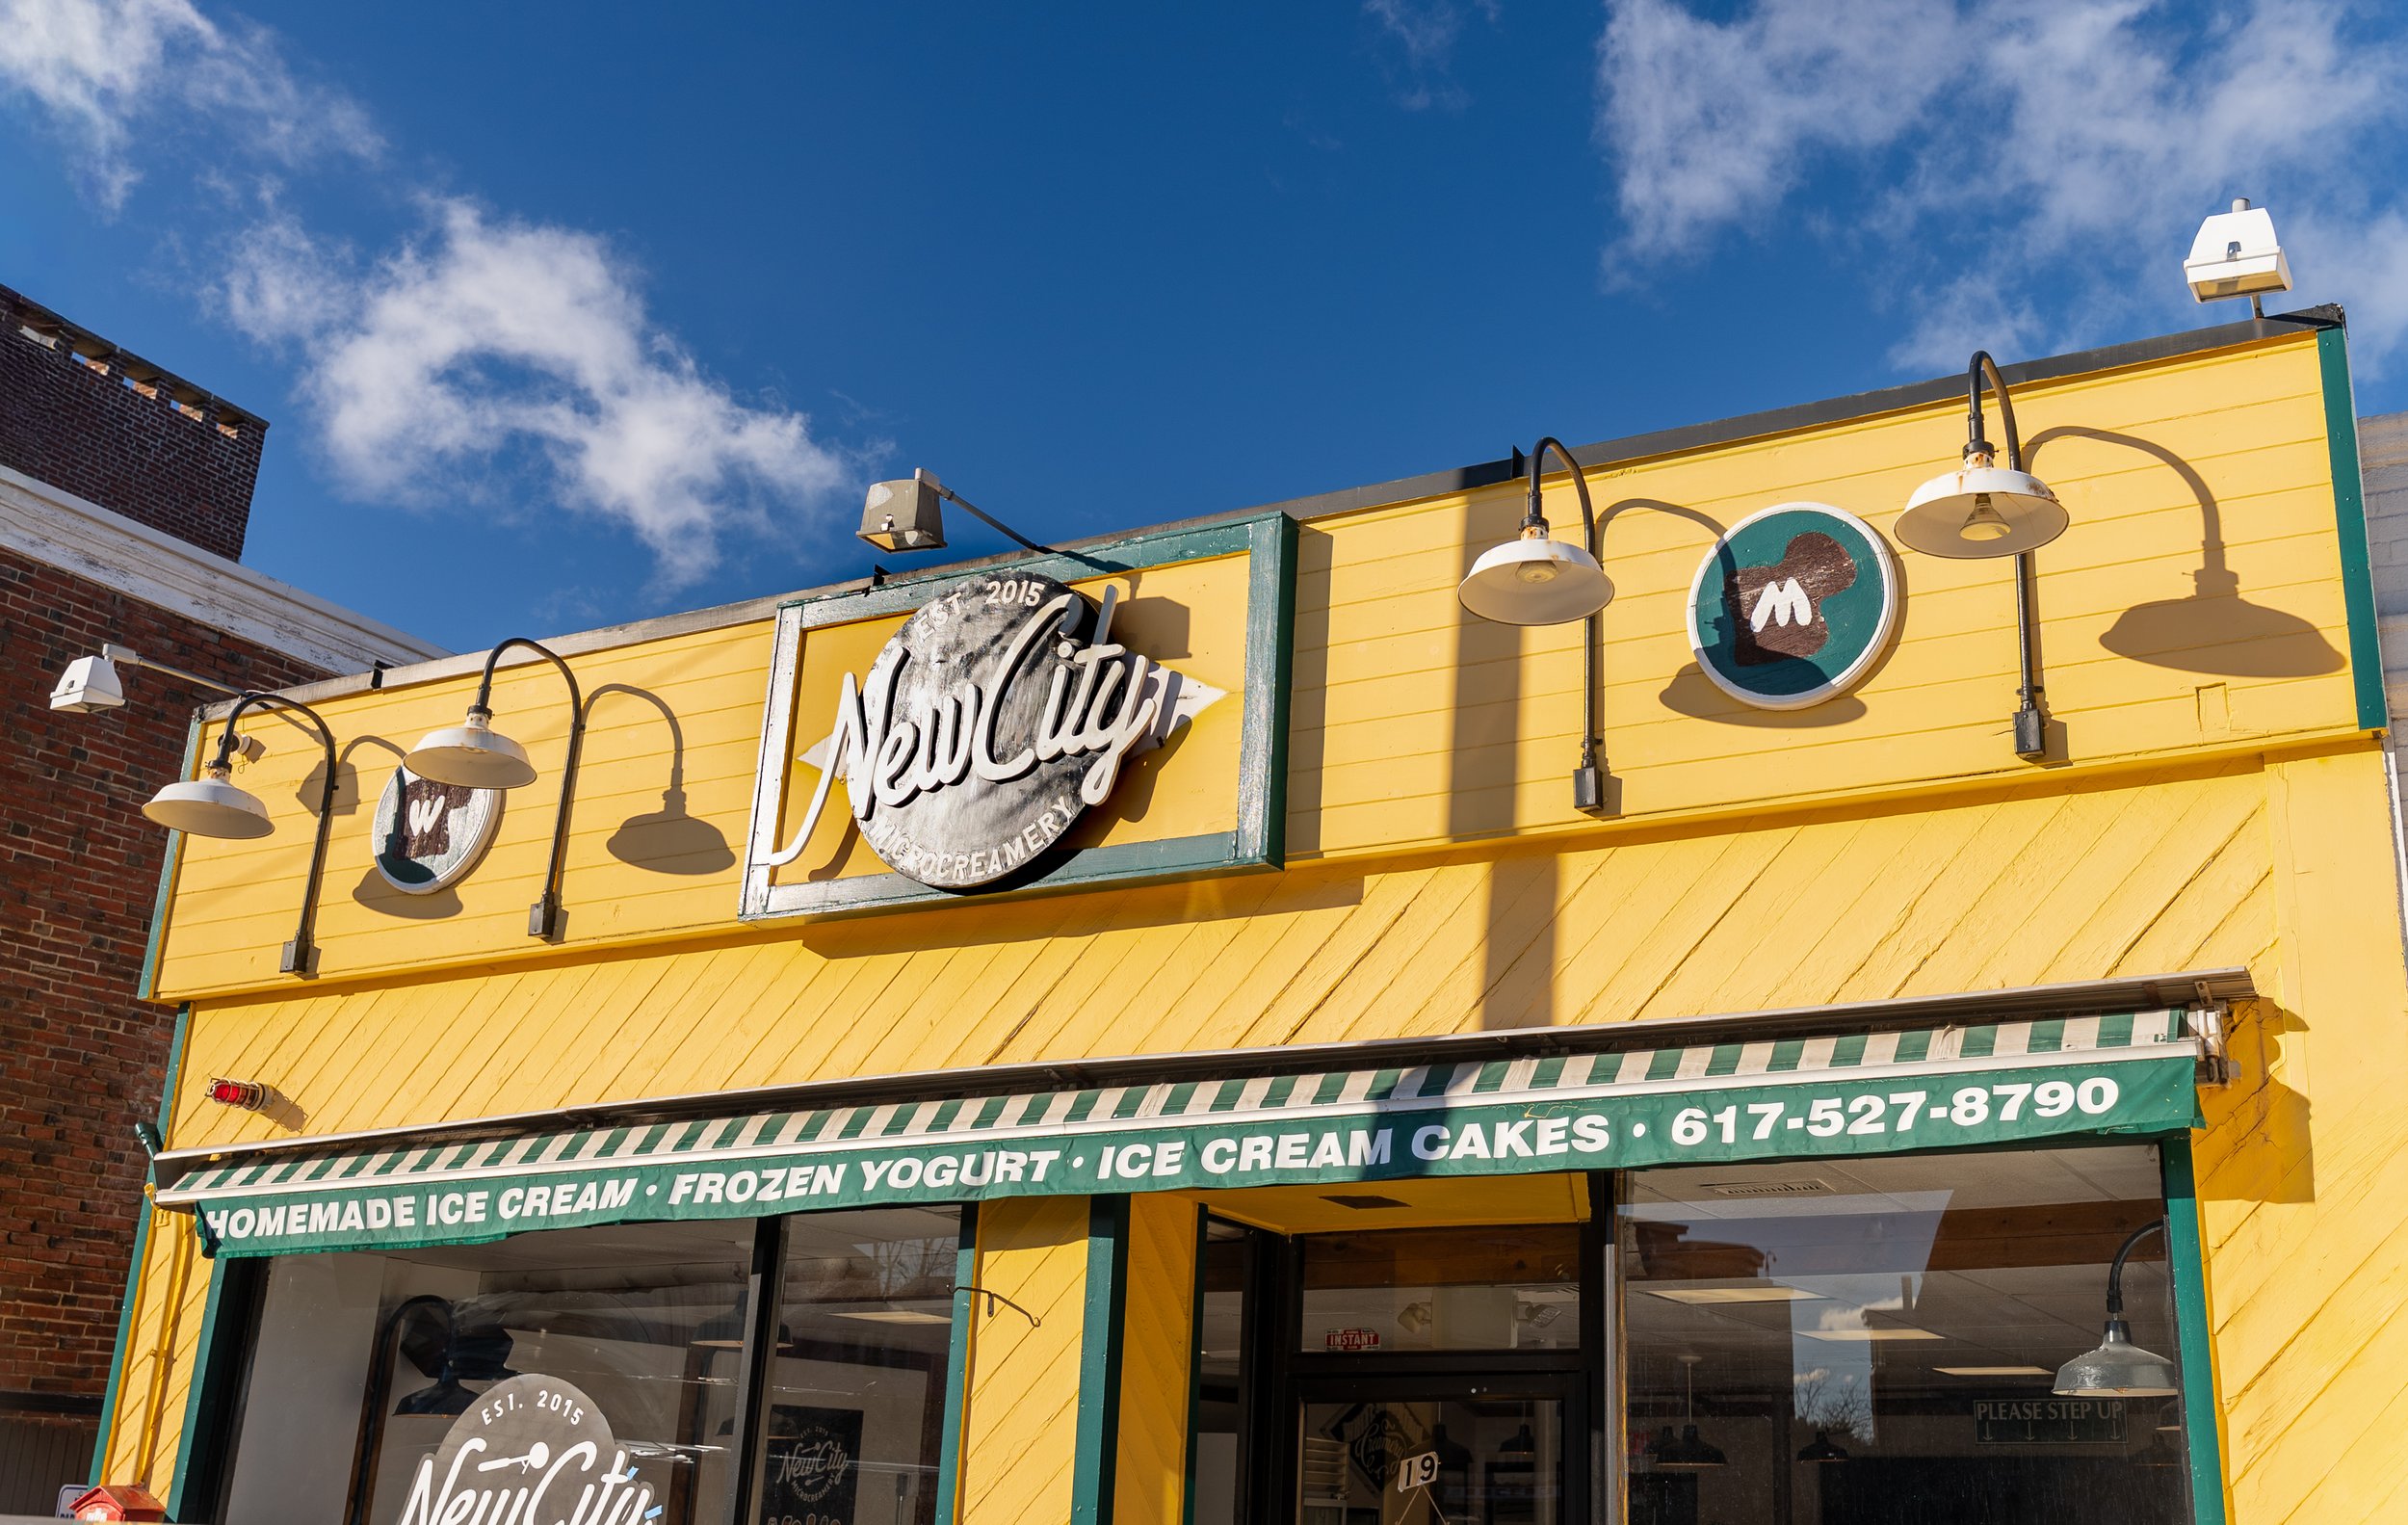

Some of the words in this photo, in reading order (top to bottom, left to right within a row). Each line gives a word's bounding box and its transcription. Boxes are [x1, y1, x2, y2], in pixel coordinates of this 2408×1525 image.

[984, 580, 1045, 607] 2015
[770, 644, 980, 867] New
[976, 584, 1156, 806] City
[869, 796, 1074, 881] MICROCREAMERY
[205, 1195, 416, 1241] HOMEMADE
[427, 1191, 489, 1226] ICE
[498, 1177, 639, 1220] CREAM
[667, 1162, 845, 1206] FROZEN
[859, 1149, 1061, 1193] YOGURT
[1096, 1141, 1186, 1180] ICE
[1200, 1128, 1393, 1174] CREAM
[1412, 1114, 1610, 1161] CAKES
[1671, 1077, 2120, 1146] 617-527-8790
[1330, 1334, 1374, 1346] INSTANT
[537, 1389, 584, 1426] 2015
[1976, 1402, 2042, 1421] PLEASE
[2047, 1401, 2091, 1420] STEP
[2097, 1401, 2124, 1419] UP
[776, 1442, 817, 1484] New
[815, 1440, 849, 1486] City
[1406, 1456, 1436, 1487] 19
